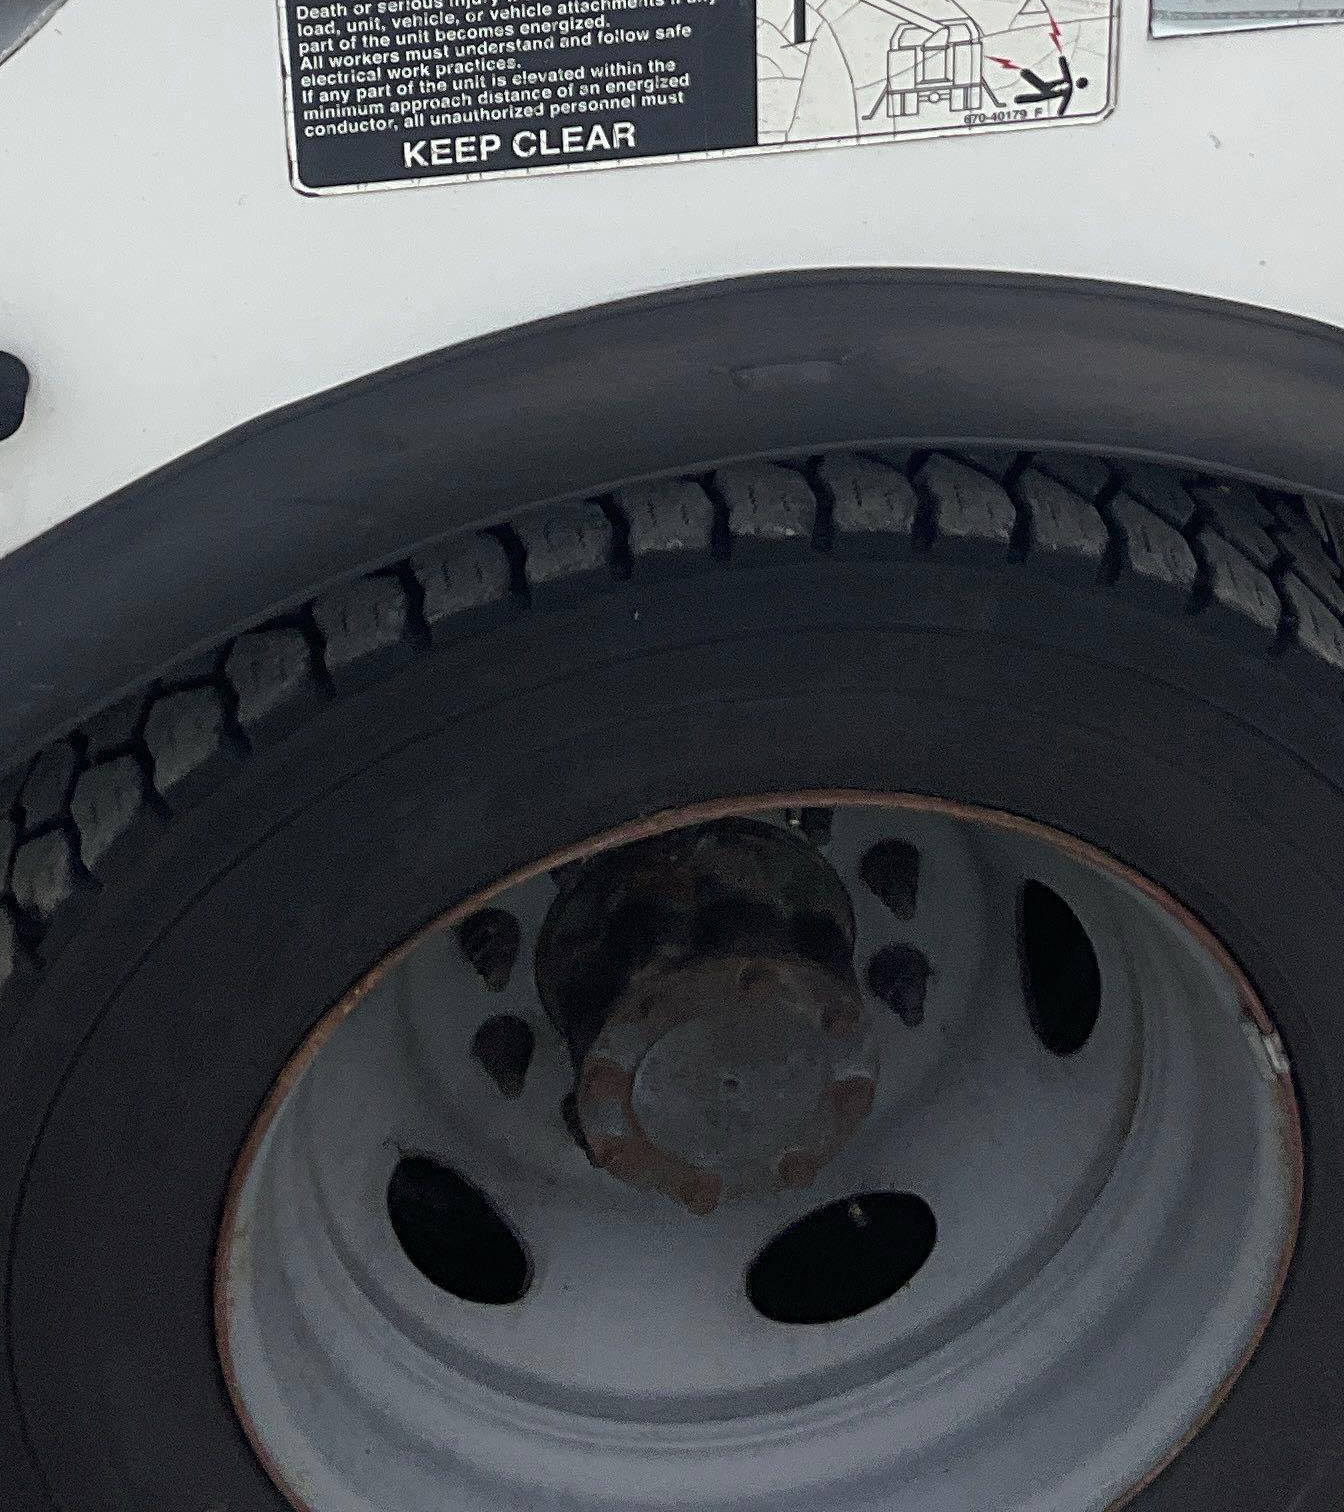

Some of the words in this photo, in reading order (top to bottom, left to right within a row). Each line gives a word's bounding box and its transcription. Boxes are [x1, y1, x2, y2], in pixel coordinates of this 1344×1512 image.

[296, 3, 347, 20] Death
[353, 2, 372, 15] or
[297, 21, 341, 37] load,
[346, 16, 386, 33] unit,
[391, 11, 460, 29] vehicle,
[465, 10, 484, 23] or
[490, 3, 552, 21] vehicle
[298, 39, 334, 57] part
[339, 36, 357, 51] of
[361, 33, 391, 49] the
[395, 29, 430, 45] unit
[435, 22, 514, 41] becomes
[520, 14, 610, 35] energized.
[300, 55, 323, 71] All
[329, 50, 400, 68] workers
[405, 45, 450, 62] must
[455, 35, 554, 57] understand
[559, 33, 592, 48] and
[597, 28, 649, 45] follow
[655, 24, 692, 40] safe
[300, 68, 381, 88] electrical
[386, 63, 430, 80] work
[435, 57, 521, 78] practices.
[302, 89, 314, 104] If
[319, 88, 350, 104] any
[356, 83, 392, 102] part
[396, 80, 415, 95] of
[418, 78, 447, 93] the
[452, 73, 486, 90] unit
[491, 72, 507, 87] is
[511, 65, 585, 86] elevated
[590, 61, 643, 78] within
[648, 59, 677, 74] the
[303, 102, 385, 121] minimum
[389, 92, 473, 116] approach
[477, 86, 552, 105] distance
[557, 83, 574, 98] of
[579, 83, 601, 96] an
[605, 73, 690, 95] energized
[304, 118, 399, 138] conductor,
[403, 113, 424, 129] all
[430, 103, 544, 125] unauthorized
[550, 95, 636, 119] personnel
[641, 92, 684, 107] must
[402, 134, 501, 168] KEEP
[512, 121, 637, 158] CLEAR
